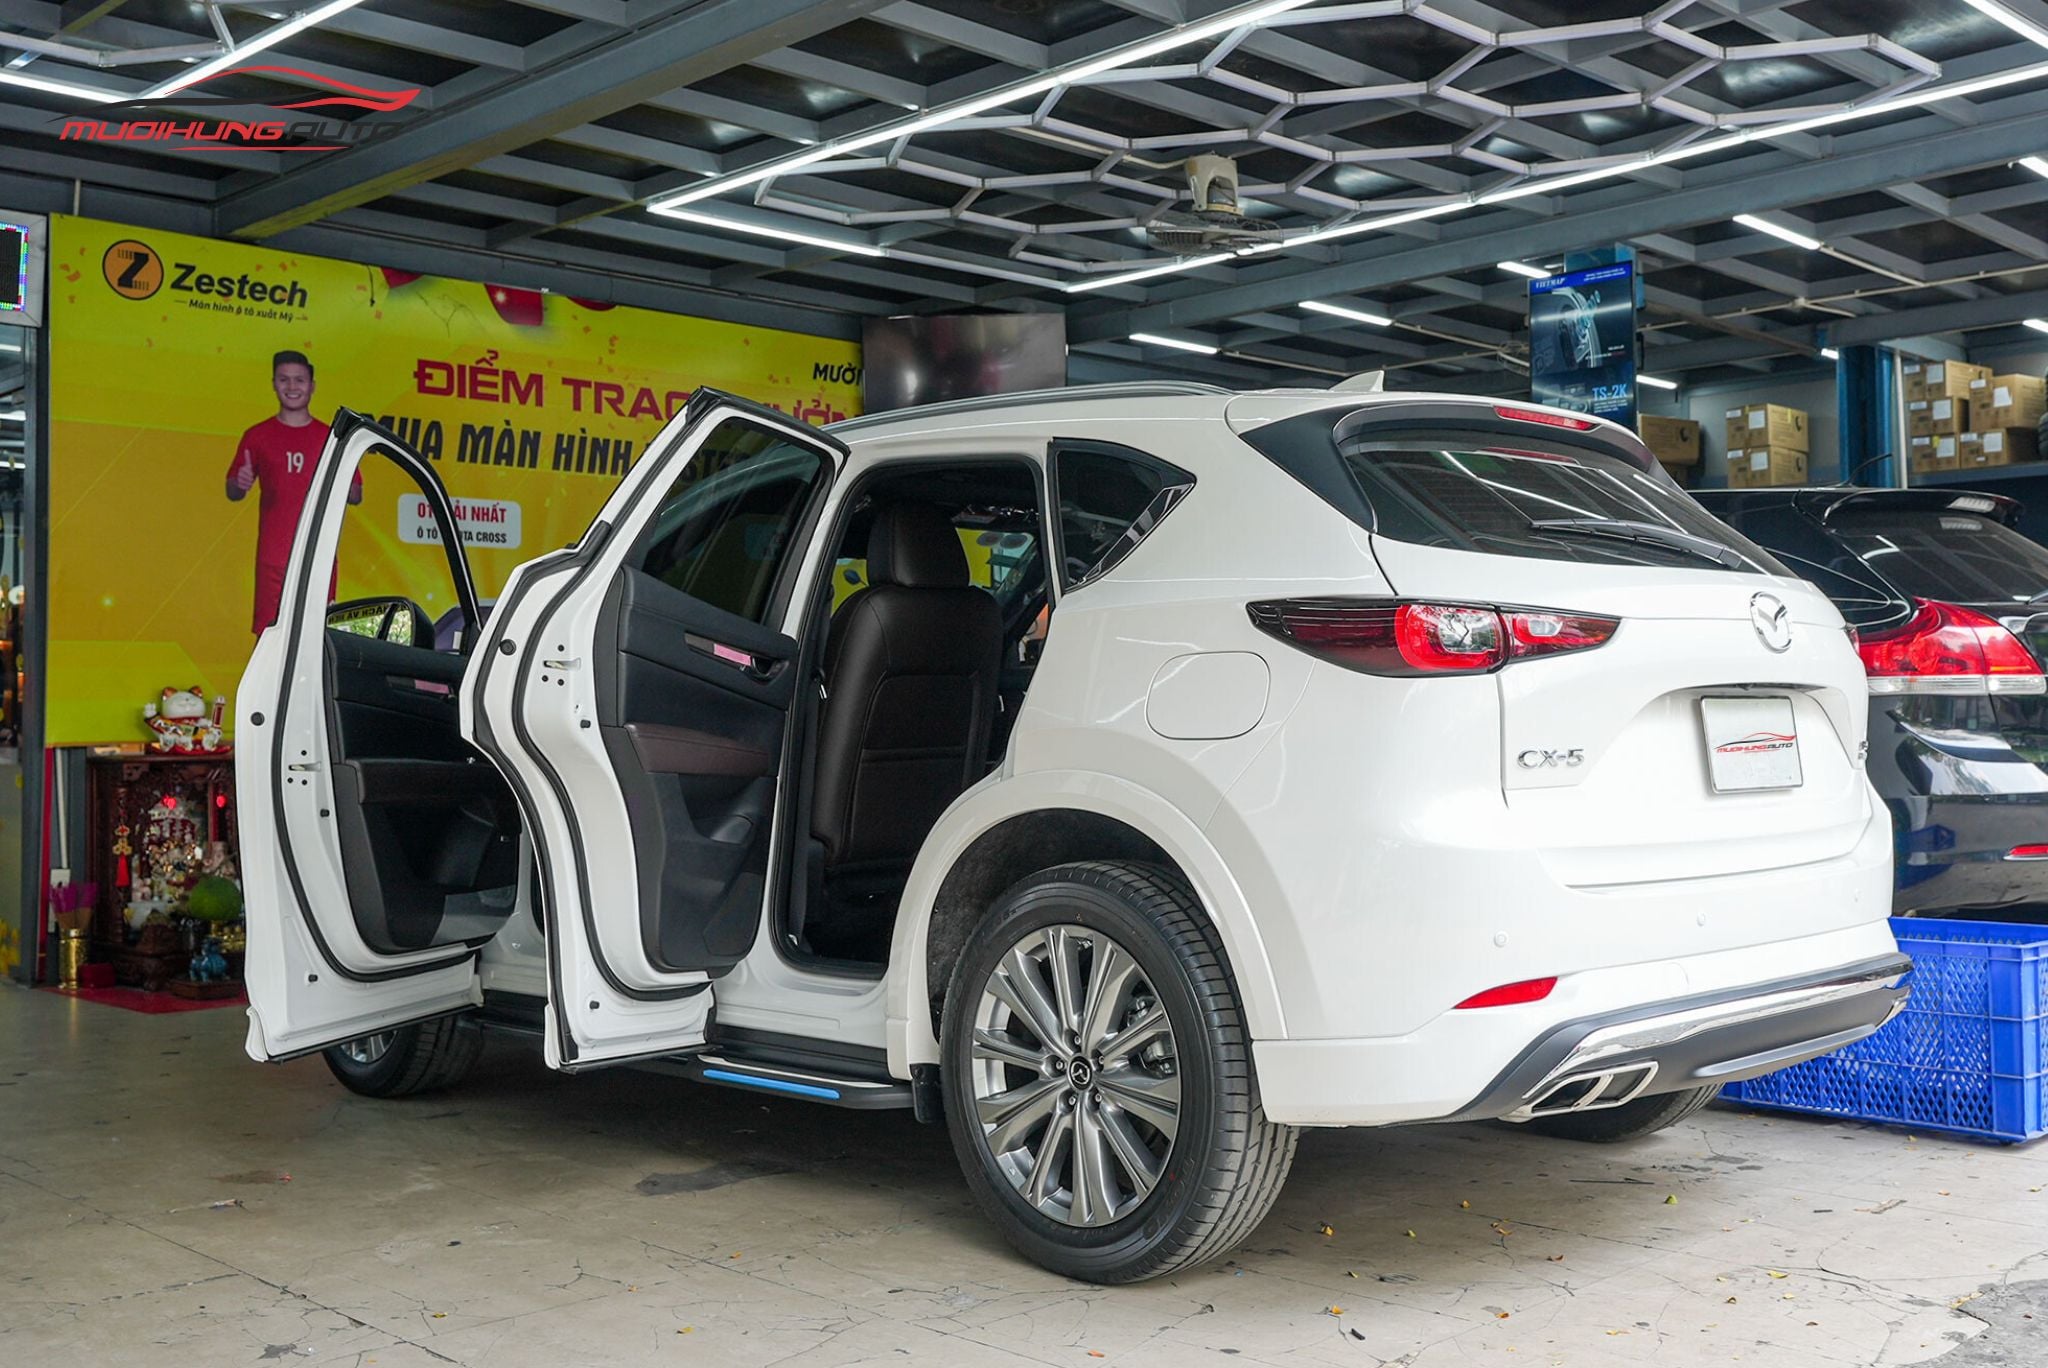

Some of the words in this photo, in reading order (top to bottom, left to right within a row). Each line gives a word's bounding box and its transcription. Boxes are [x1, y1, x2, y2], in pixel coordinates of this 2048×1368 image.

[170, 263, 308, 308] Zestech
[413, 350, 543, 408] ĐIỂM
[1592, 384, 1628, 401] TS-2K
[457, 420, 541, 469] MÀN
[552, 428, 633, 476] HÌNH
[286, 451, 304, 473] 19
[471, 501, 507, 524] NHẤT
[426, 521, 439, 540] TÔ
[476, 531, 507, 544] CROSS
[1516, 748, 1585, 769] CX-5
